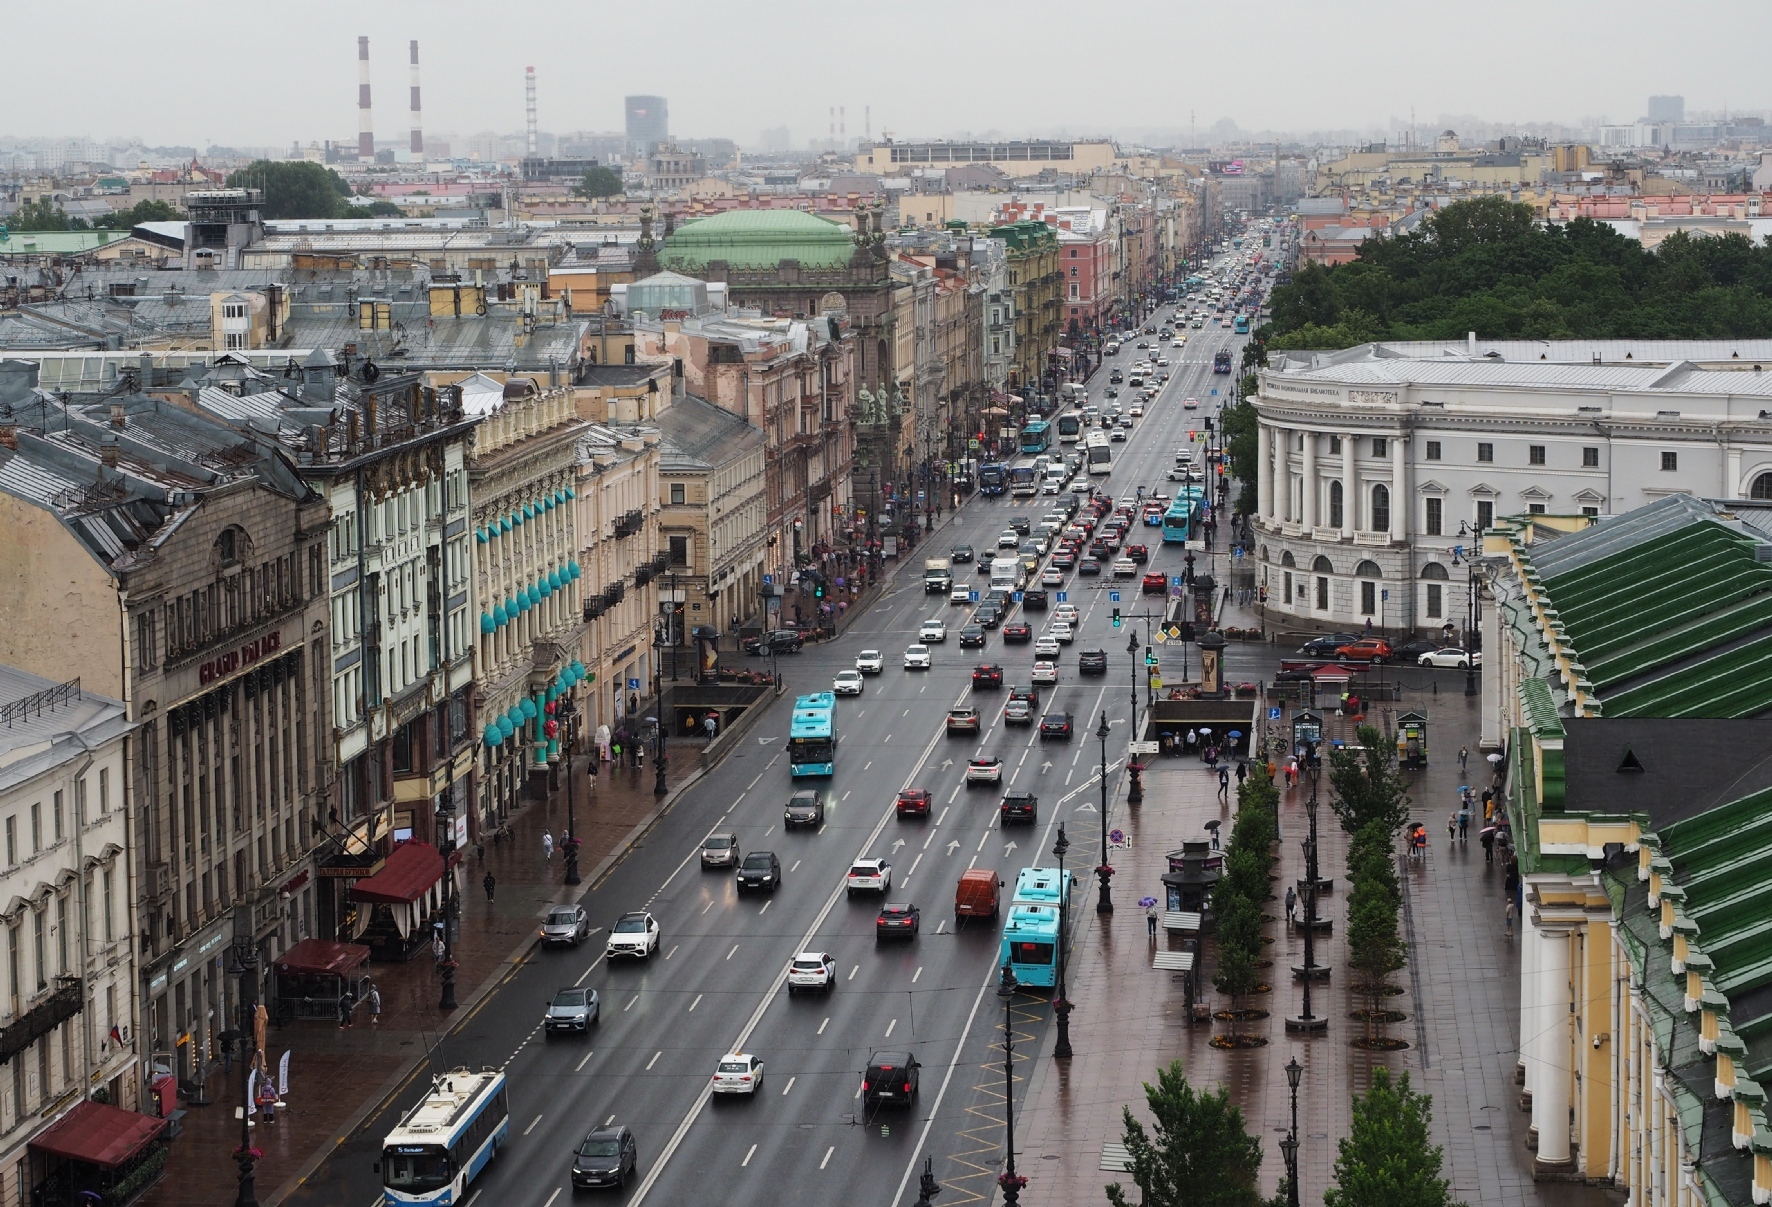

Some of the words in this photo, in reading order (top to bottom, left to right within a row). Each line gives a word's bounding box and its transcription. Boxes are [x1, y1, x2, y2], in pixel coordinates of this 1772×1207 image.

[1310, 387, 1340, 397] БИБЛИОТЕКА
[199, 651, 240, 686] GRAND
[241, 631, 281, 667] PALACE
[345, 868, 370, 876] БУТИКОВ
